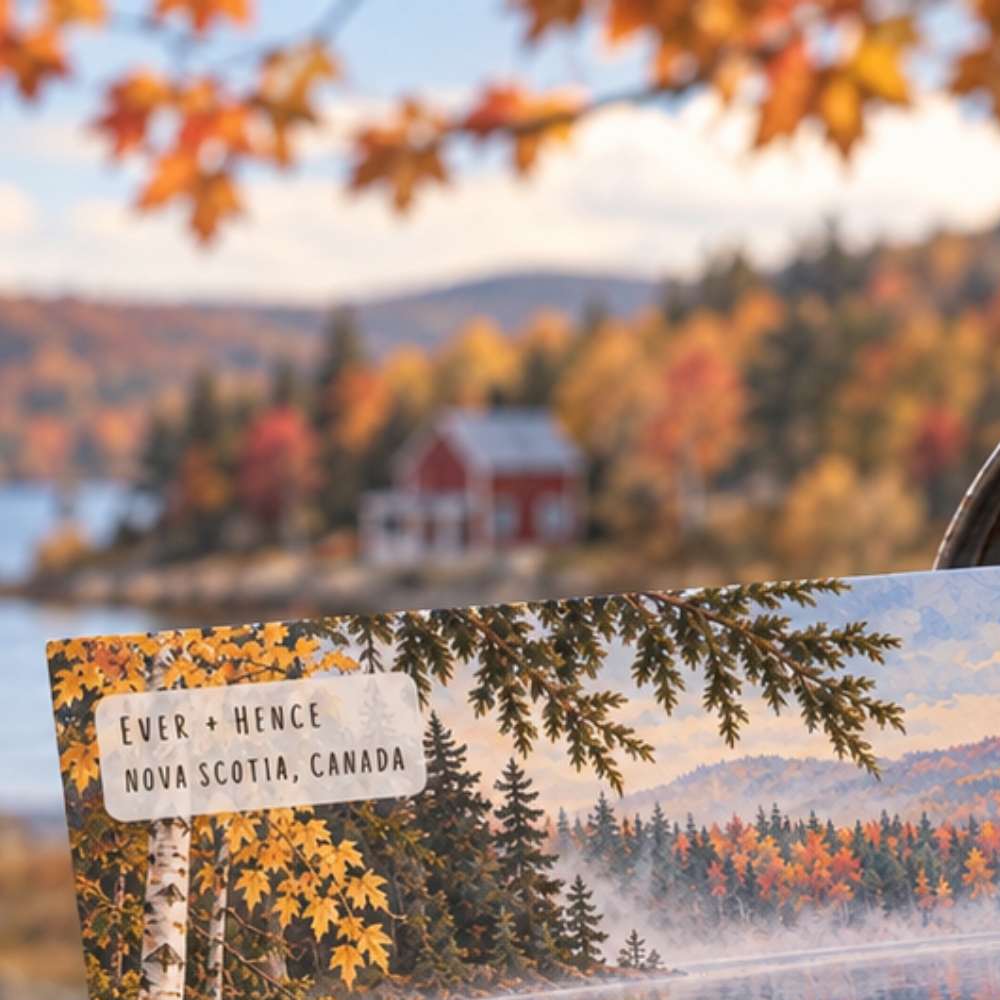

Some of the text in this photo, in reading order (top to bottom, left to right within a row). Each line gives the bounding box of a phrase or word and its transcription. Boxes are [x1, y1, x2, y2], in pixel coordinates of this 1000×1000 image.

[120, 714, 189, 745] EVER
[234, 702, 322, 735] HENCE
[125, 746, 406, 793] NOVA SCOTIA, CANADA
